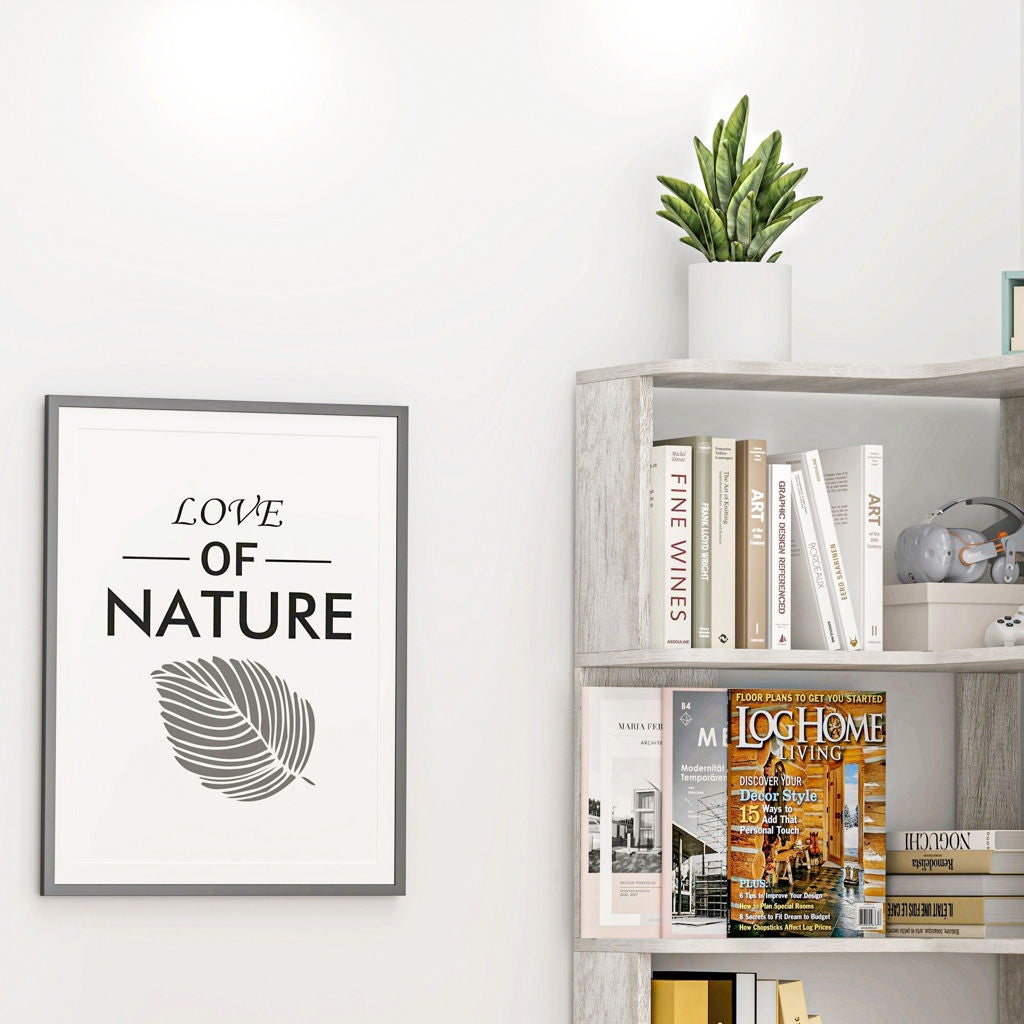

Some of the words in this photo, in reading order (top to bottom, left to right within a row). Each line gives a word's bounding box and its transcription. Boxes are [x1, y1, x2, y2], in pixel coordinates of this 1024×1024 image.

[671, 474, 687, 527] FINE
[751, 489, 764, 522] ART
[171, 495, 284, 527] LOVE
[701, 502, 709, 526] FRANK
[868, 494, 881, 526] ART
[701, 527, 709, 551] LLOYD
[200, 541, 258, 576] OF
[701, 552, 709, 581] WRIGHT
[830, 543, 843, 580] SAARINEN
[670, 540, 687, 621] WINES
[106, 587, 352, 640] NATURE
[736, 693, 763, 702] FLOOR
[765, 693, 793, 702] PLANS
[796, 694, 806, 702] TO
[808, 694, 824, 703] GET
[827, 694, 844, 703] YOU
[846, 694, 883, 703] STARTED
[618, 722, 645, 730] MARIA
[780, 745, 843, 761] LIVING
[681, 764, 725, 772] Modernität
[739, 776, 779, 786] DISCOVER
[780, 776, 802, 786] YOUR
[739, 789, 779, 802] Decor
[782, 789, 818, 805] Style
[739, 805, 760, 824] 15
[762, 805, 783, 815] Ways
[762, 815, 778, 824] Add
[780, 815, 798, 824] That
[739, 826, 774, 835] Personal
[776, 826, 800, 835] Touch
[905, 832, 971, 850] NOGUCHI
[912, 858, 954, 871] Remodelista
[739, 879, 768, 889] PLUS:
[745, 892, 757, 900] Tips
[765, 892, 788, 900] Improve
[804, 892, 823, 900] Design
[774, 903, 793, 911] Special
[887, 903, 900, 920] CAFÉ
[900, 903, 908, 917] LE
[908, 903, 920, 917] FOIS
[920, 903, 932, 917] UNE
